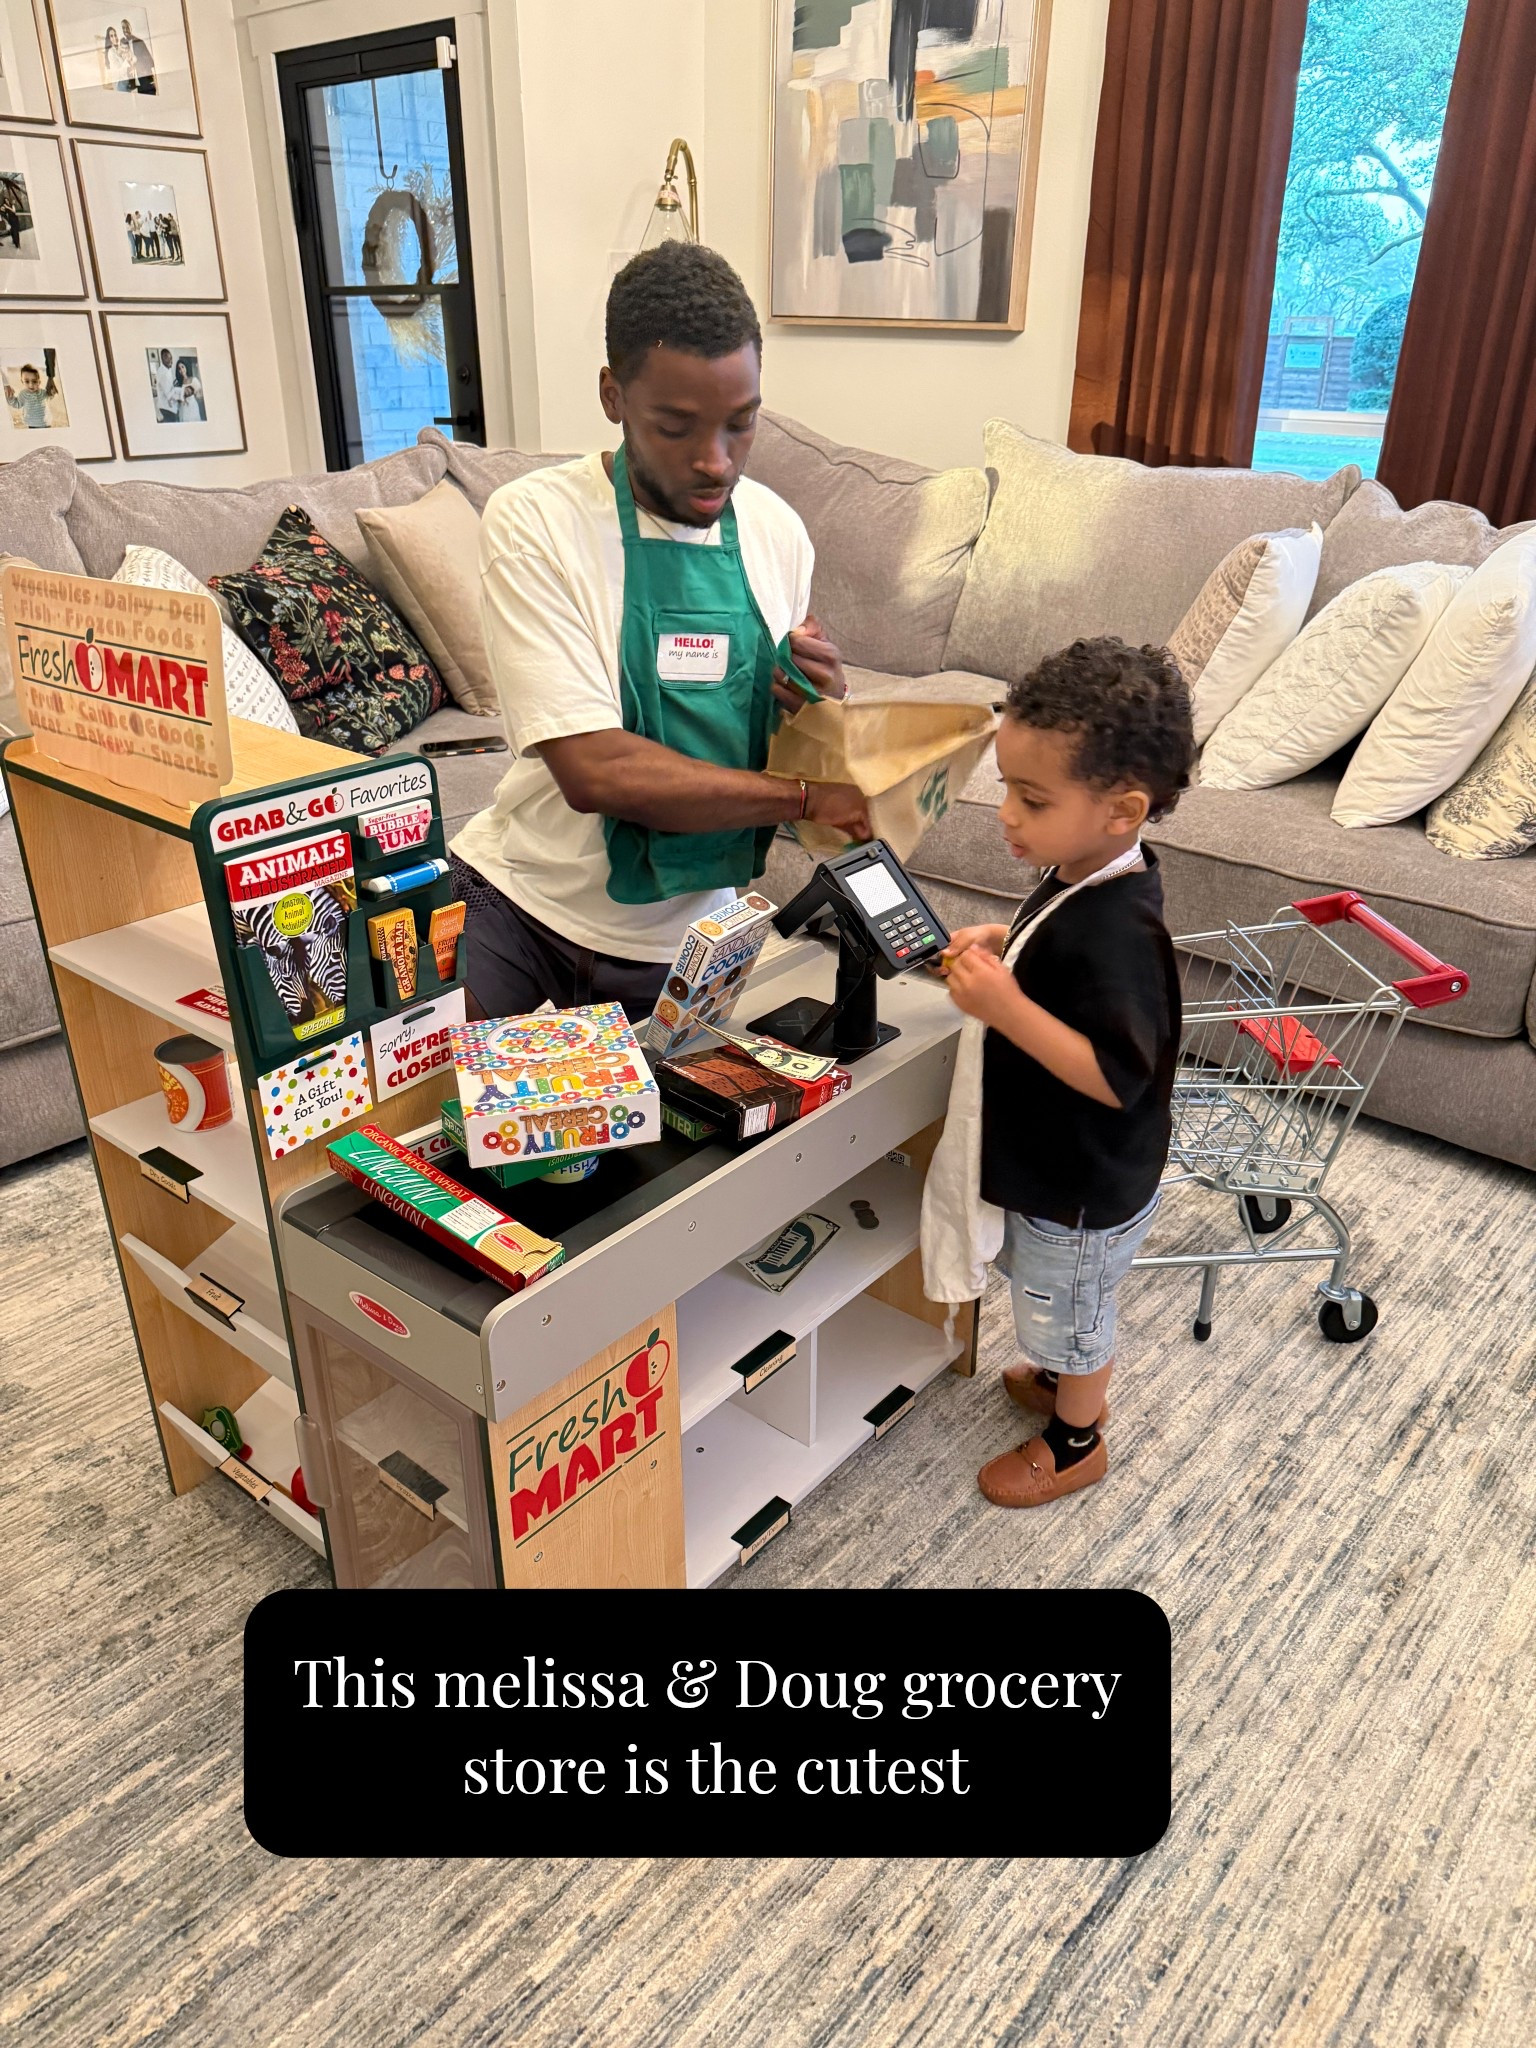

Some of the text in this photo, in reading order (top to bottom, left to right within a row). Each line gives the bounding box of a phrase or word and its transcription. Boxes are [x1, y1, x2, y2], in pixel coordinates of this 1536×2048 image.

[104, 589, 153, 616] Dairy
[170, 600, 206, 625] Deli
[20, 600, 194, 650] Fish Frozen Foods
[669, 650, 683, 659] my
[712, 650, 718, 658] is
[675, 637, 714, 648] HELLO!
[17, 635, 208, 718] Fresh MART
[78, 702, 144, 734] Canne
[151, 745, 219, 779] Snacks
[350, 774, 427, 807] Favorites
[369, 813, 420, 836] BUBBLE
[239, 838, 345, 886] ANIMALS
[241, 858, 348, 900] ILLUSTRATED
[314, 871, 348, 888] MAGAZINE
[285, 907, 304, 920] Animal
[709, 901, 746, 922] COOKIES
[395, 921, 412, 992] GRANOLA BAR
[676, 934, 695, 974] COOKIES
[685, 942, 707, 980] SANDWICH
[702, 939, 763, 982] COOKIES
[301, 1016, 334, 1036] SPECIAL
[380, 1026, 416, 1059] Sorry,
[387, 1049, 452, 1088] CLOSED
[471, 1053, 630, 1086] CEREAL
[478, 1065, 639, 1103] FRUITY
[294, 1091, 343, 1121] for You!
[298, 1080, 336, 1106] A Gift
[520, 1105, 608, 1134] CEREAL
[663, 1104, 691, 1136] TTER
[524, 1124, 610, 1156] FRUITY
[348, 1149, 452, 1205] LINGUINI
[362, 1127, 405, 1156] ORGANIC
[402, 1152, 437, 1178] WHOLE
[434, 1174, 470, 1199] WHEAT
[362, 1178, 428, 1230] LINGUINI
[759, 1354, 784, 1377] Cleaning
[509, 1379, 627, 1492] Fresh
[232, 1467, 258, 1490] Vegetables
[510, 1385, 663, 1541] MART
